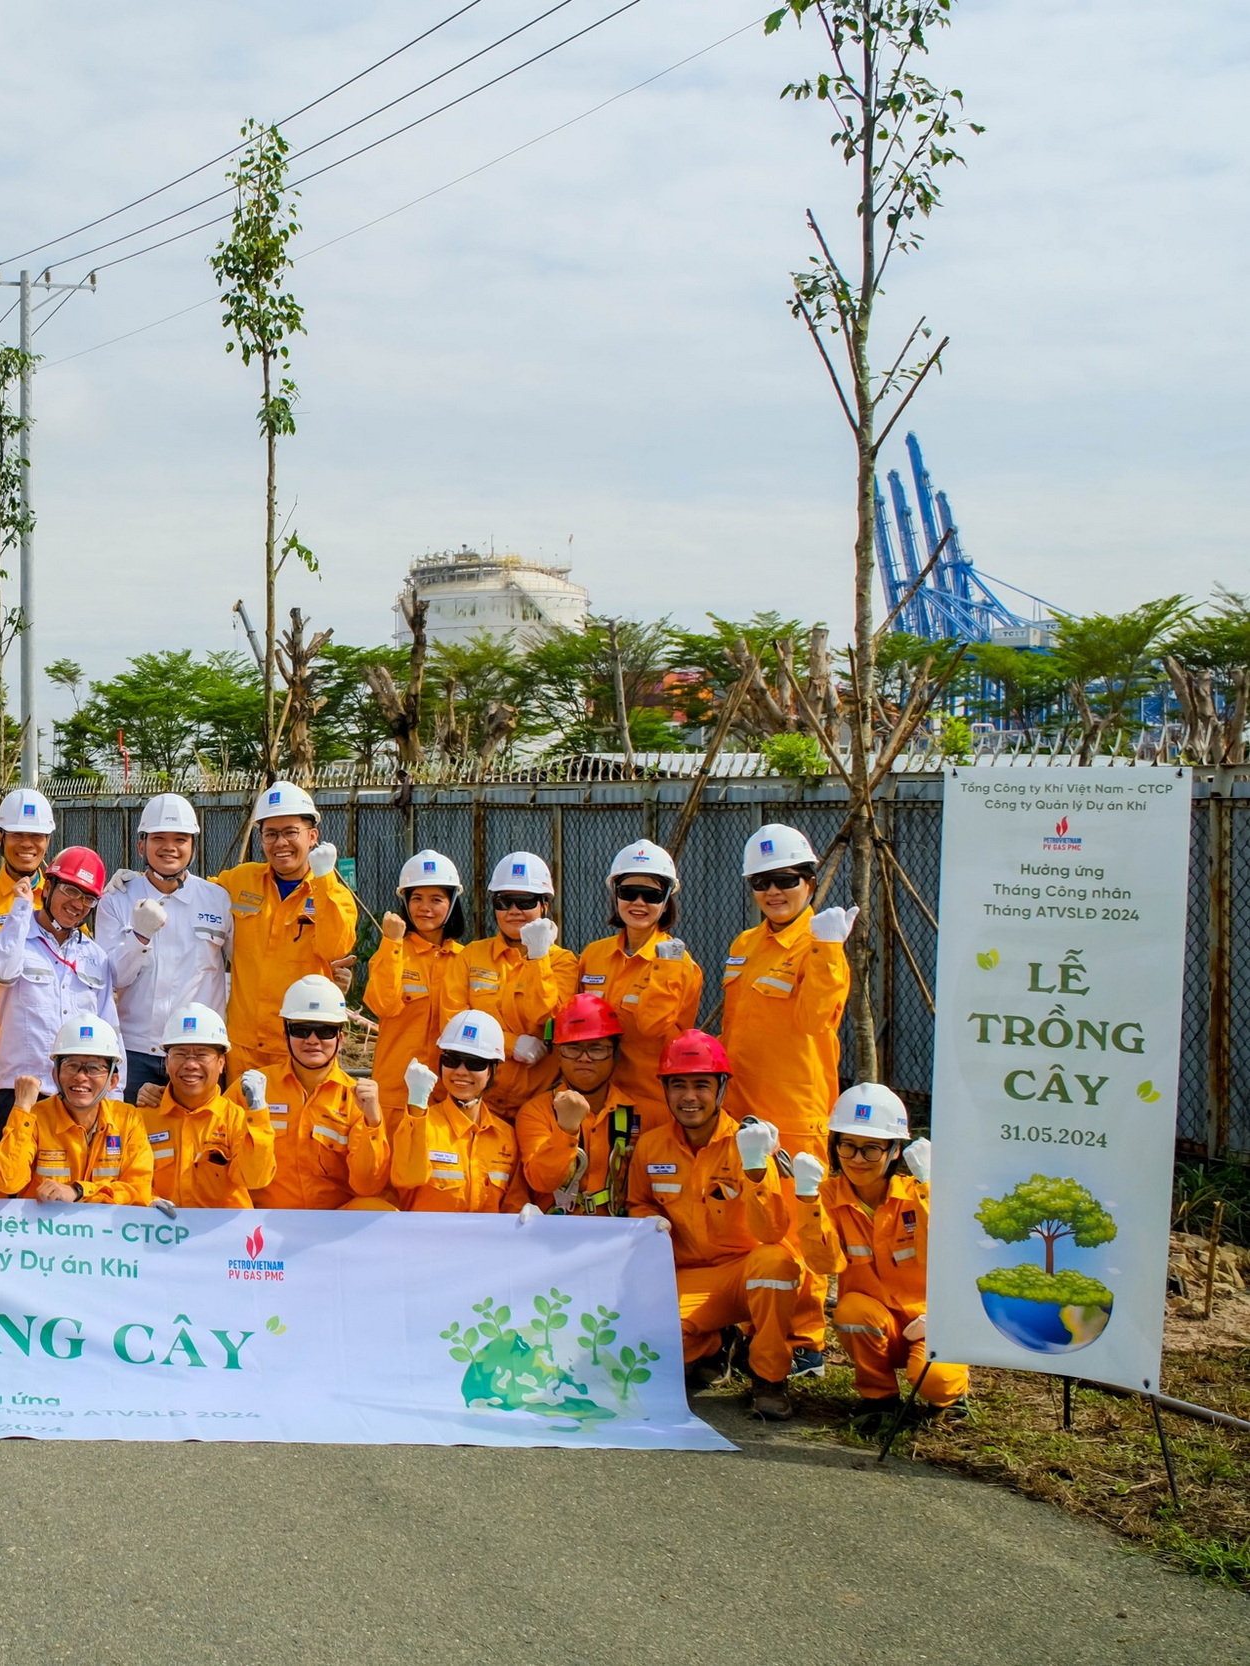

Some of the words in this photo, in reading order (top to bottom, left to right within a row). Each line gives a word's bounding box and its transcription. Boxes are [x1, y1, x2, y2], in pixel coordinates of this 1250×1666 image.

[960, 783, 990, 796] Tổng
[993, 783, 1027, 795] Công
[1029, 785, 1040, 795] ty
[1044, 783, 1063, 793] Khí
[1066, 783, 1091, 796] Việt
[1094, 784, 1124, 794] Nam
[1137, 784, 1173, 794] CTCP
[984, 799, 1017, 811] Công
[1020, 801, 1032, 812] ty
[1035, 800, 1069, 811] Quản
[1072, 800, 1082, 813] lý
[1086, 801, 1104, 813] Dự
[1108, 801, 1123, 811] án
[1126, 801, 1147, 811] Khí
[1020, 863, 1070, 879] Hưởng
[1075, 865, 1104, 880] ứng
[993, 883, 1041, 899] Tháng
[1045, 885, 1087, 901] Công
[1092, 887, 1131, 899] nhân
[197, 912, 223, 926] PTSC
[983, 904, 1032, 920] Tháng
[1036, 906, 1097, 920] ATVSLĐ
[1101, 908, 1140, 921] 2024
[1027, 948, 1091, 996] LỄ
[967, 1003, 1146, 1055] TRỒNG
[1003, 1063, 1110, 1106] CÂY
[1000, 1124, 1108, 1148] 31.05.2024
[37, 1217, 94, 1238] Nam
[121, 1222, 190, 1244] CTCP
[20, 1249, 55, 1277] Dự
[61, 1254, 92, 1275] án
[100, 1257, 139, 1279] Khí
[228, 1259, 284, 1271] PETROVIETNAM
[228, 1269, 240, 1280] PV
[242, 1270, 262, 1281] GAS
[264, 1271, 284, 1281] PMC
[112, 1313, 256, 1370] CÂY
[11, 1391, 61, 1407] ứng
[83, 1409, 187, 1418] ATVSLĐ
[196, 1411, 261, 1419] 2024
